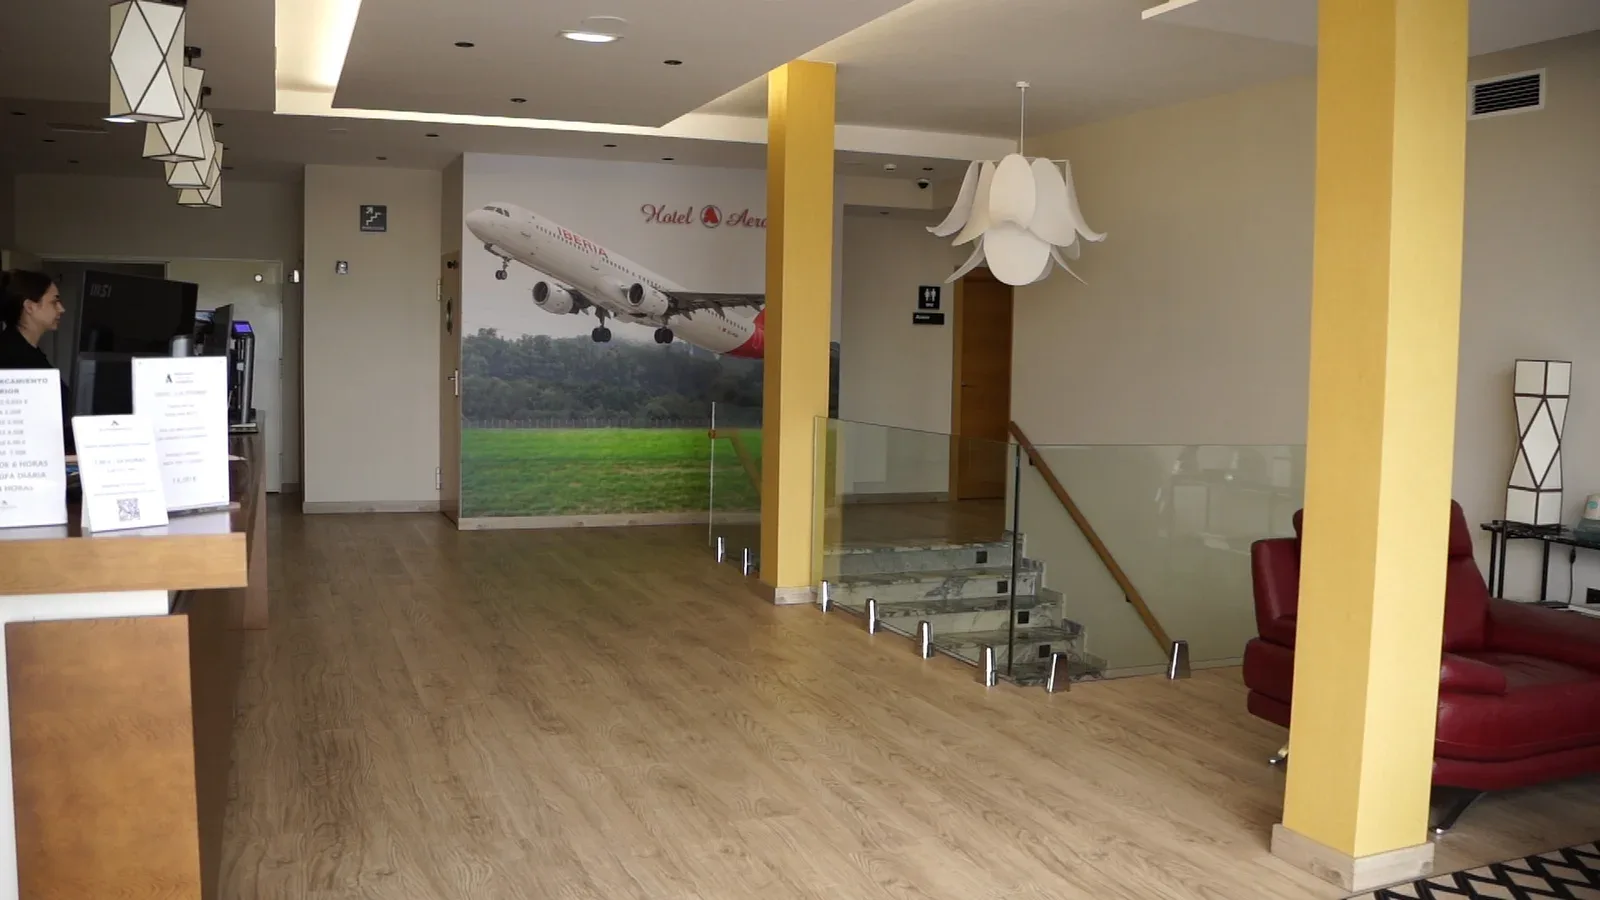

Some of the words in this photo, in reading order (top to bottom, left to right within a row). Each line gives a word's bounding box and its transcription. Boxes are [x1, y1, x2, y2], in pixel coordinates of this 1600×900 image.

[641, 203, 693, 225] Hotel
[557, 226, 608, 258] IBERIA
[19, 460, 48, 468] HORAS
